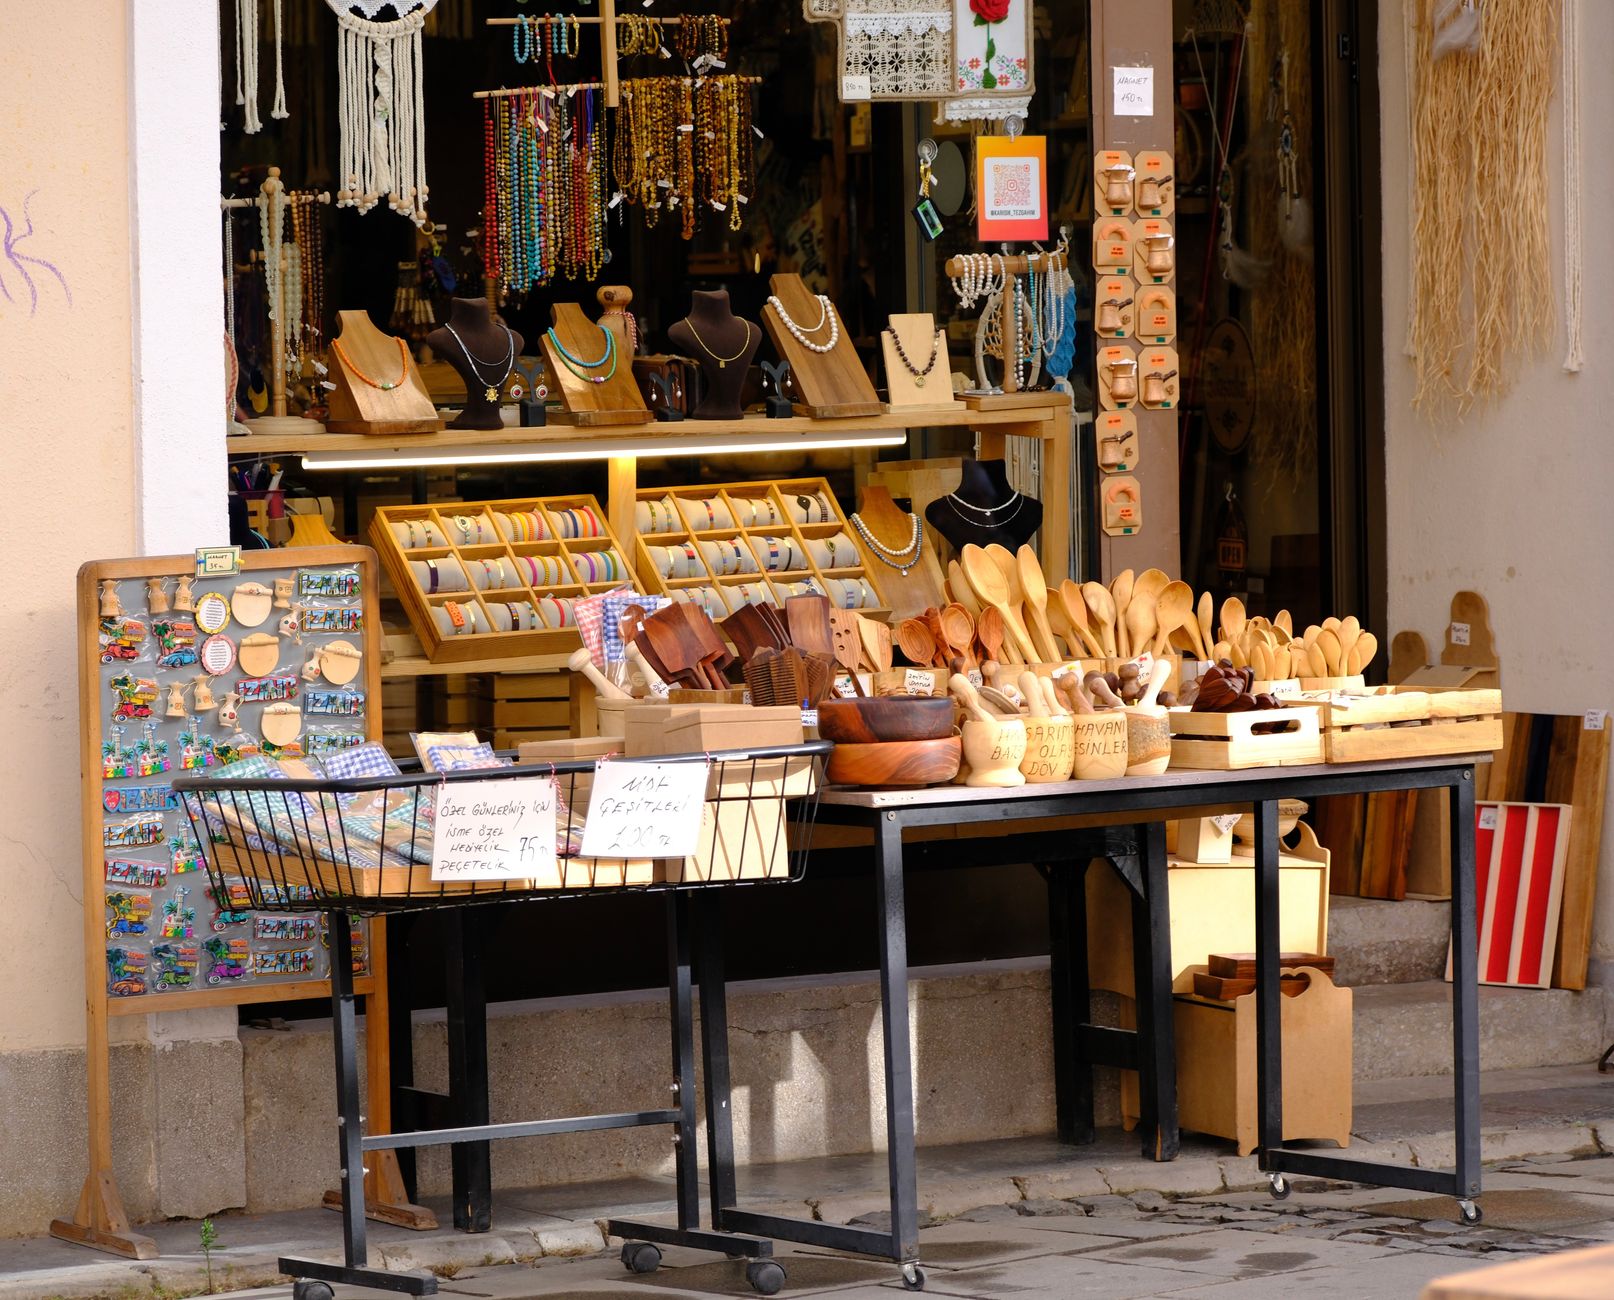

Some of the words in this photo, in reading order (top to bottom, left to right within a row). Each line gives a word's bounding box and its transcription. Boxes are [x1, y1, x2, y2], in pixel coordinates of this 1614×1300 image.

[1117, 77, 1148, 85] MAGNET
[1121, 92, 1135, 103] 150
[440, 798, 466, 817] ÖZEL
[472, 801, 526, 830] GÜNLERİNİZ
[533, 799, 551, 815] İÇİN
[446, 823, 473, 839] İSME
[479, 824, 505, 843] ÖZEL
[520, 836, 544, 861] 75
